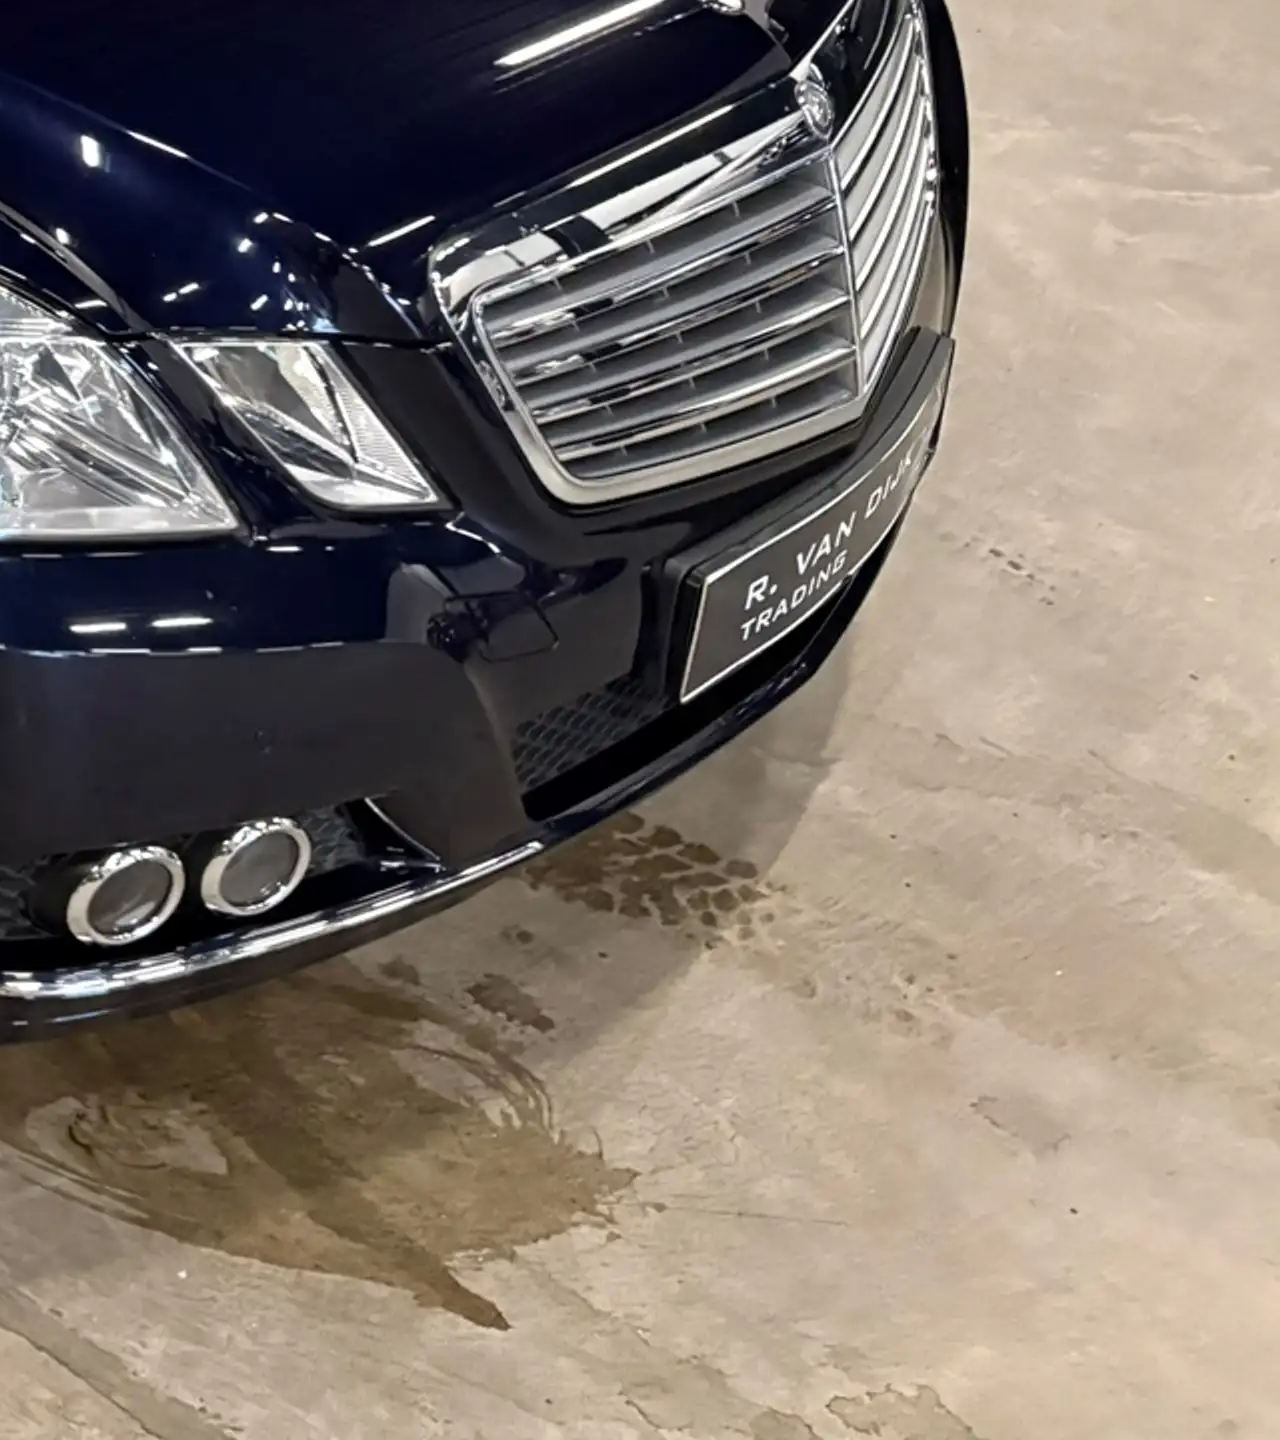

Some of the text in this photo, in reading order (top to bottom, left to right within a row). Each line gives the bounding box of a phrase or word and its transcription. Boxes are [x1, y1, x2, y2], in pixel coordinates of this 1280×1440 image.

[741, 550, 849, 641] TRADING
[743, 574, 778, 611] R.
[796, 512, 856, 574] VAN
